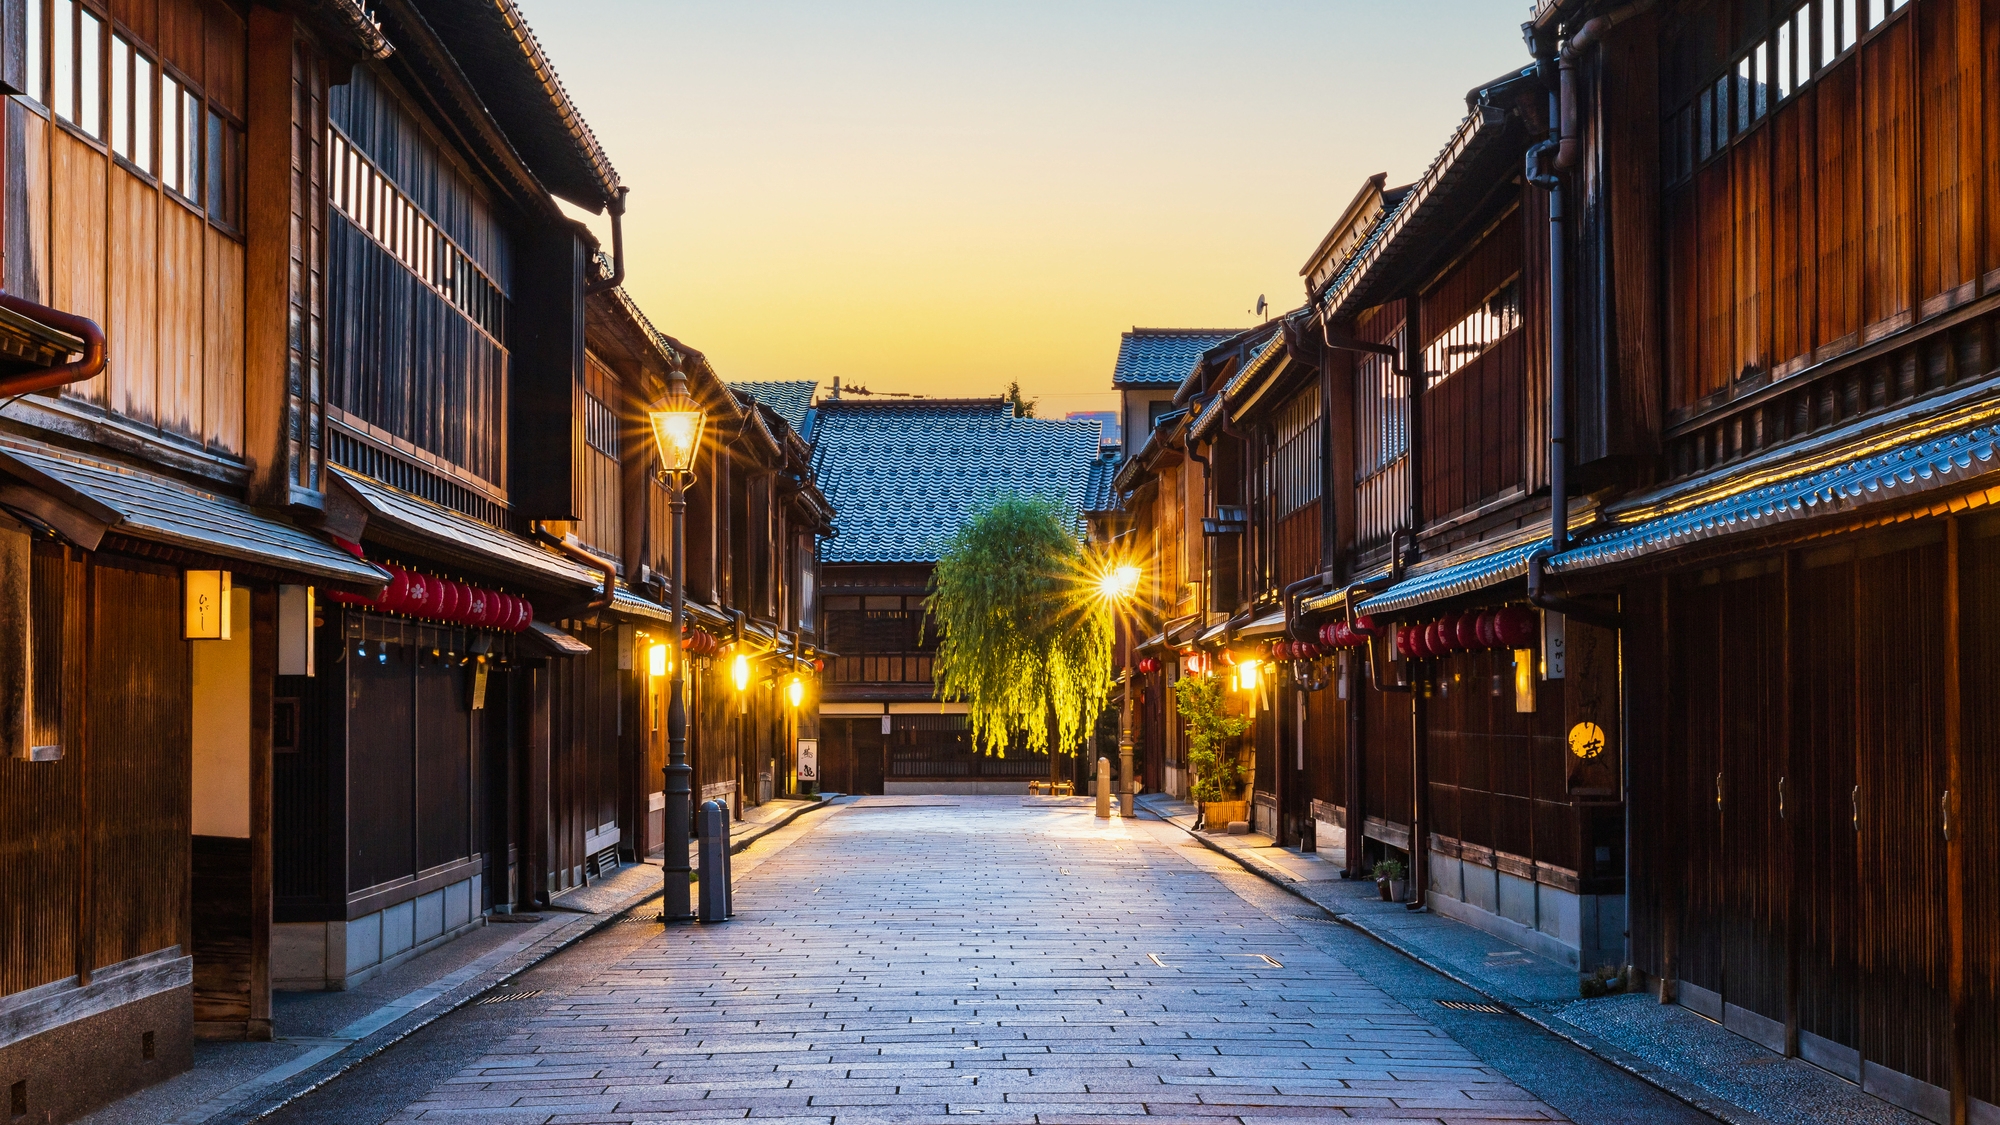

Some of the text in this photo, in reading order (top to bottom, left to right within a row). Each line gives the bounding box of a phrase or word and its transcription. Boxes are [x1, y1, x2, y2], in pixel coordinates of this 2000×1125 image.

[198, 594, 210, 632] ひがし
[1554, 638, 1563, 674] ひがし
